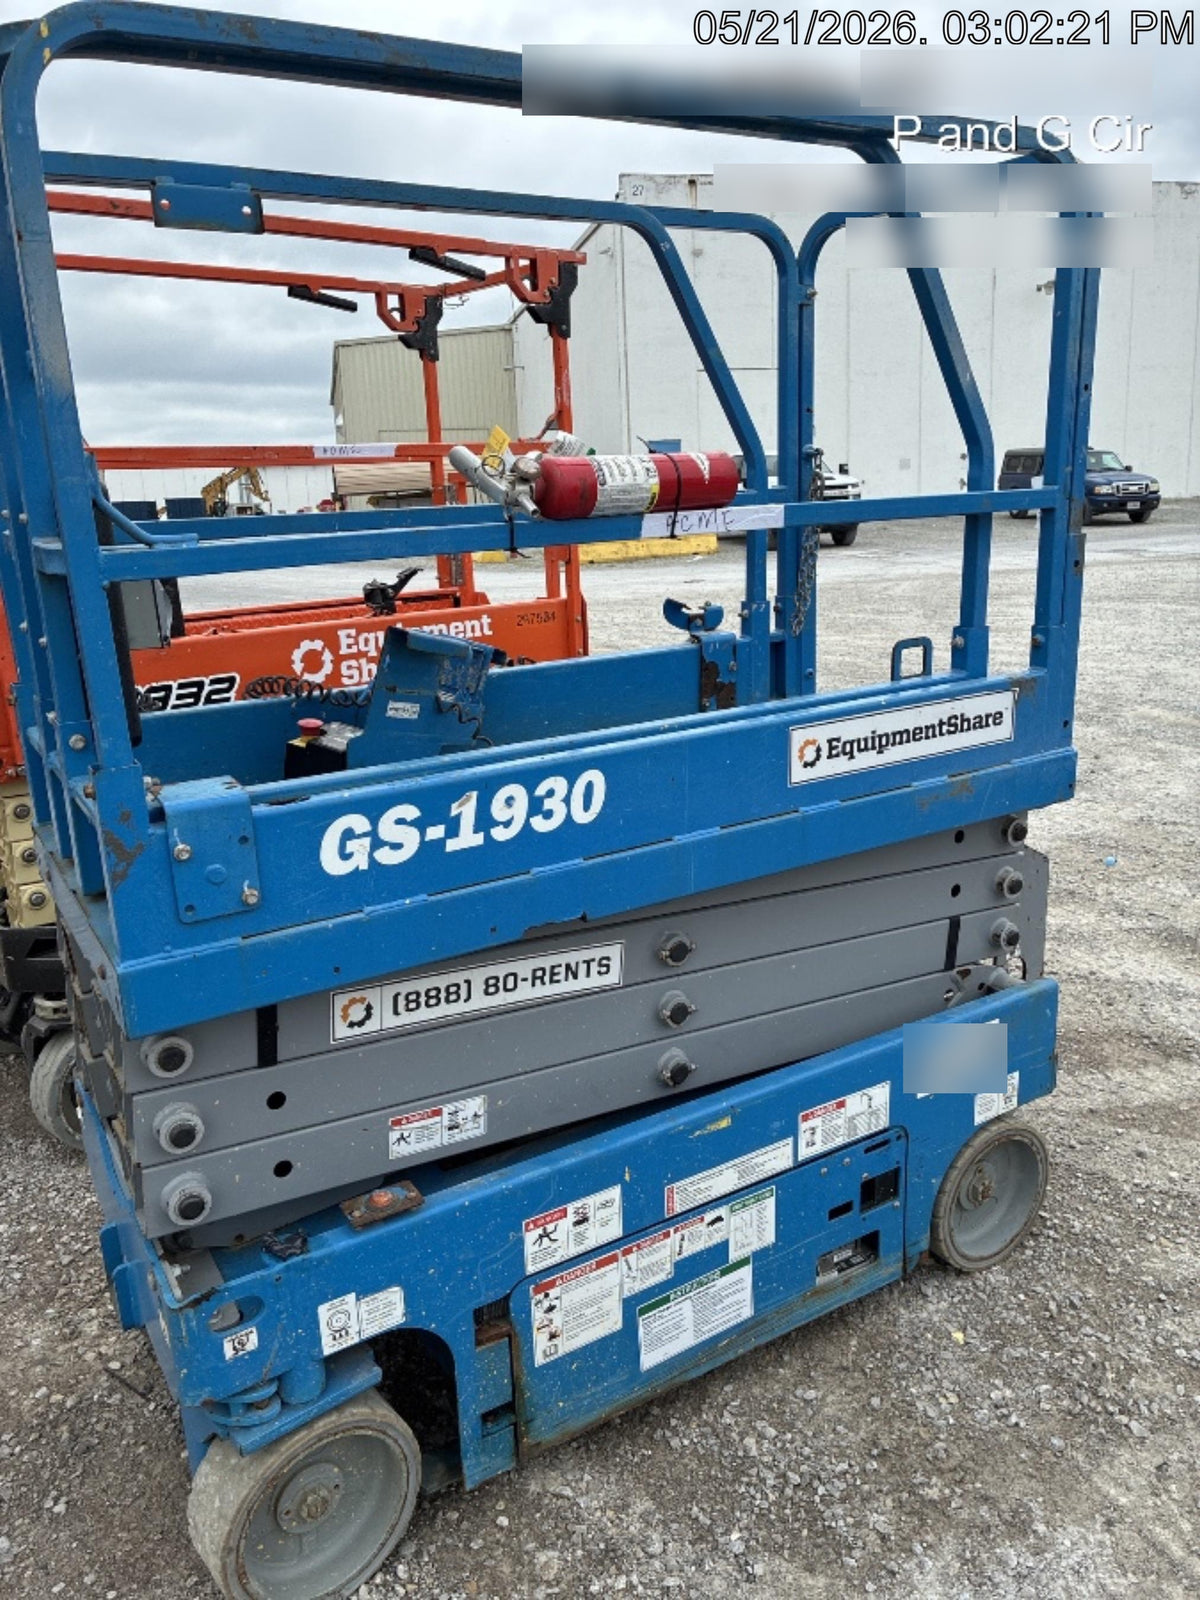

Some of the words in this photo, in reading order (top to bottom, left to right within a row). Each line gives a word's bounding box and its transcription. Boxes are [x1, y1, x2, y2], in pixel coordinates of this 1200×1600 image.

[632, 184, 644, 196] 27
[337, 614, 493, 656] Eqment
[826, 708, 1004, 761] EquipmentShare
[319, 768, 607, 876] GS-1930
[392, 979, 473, 1016] (888)
[483, 955, 612, 996] 80-RENTS
